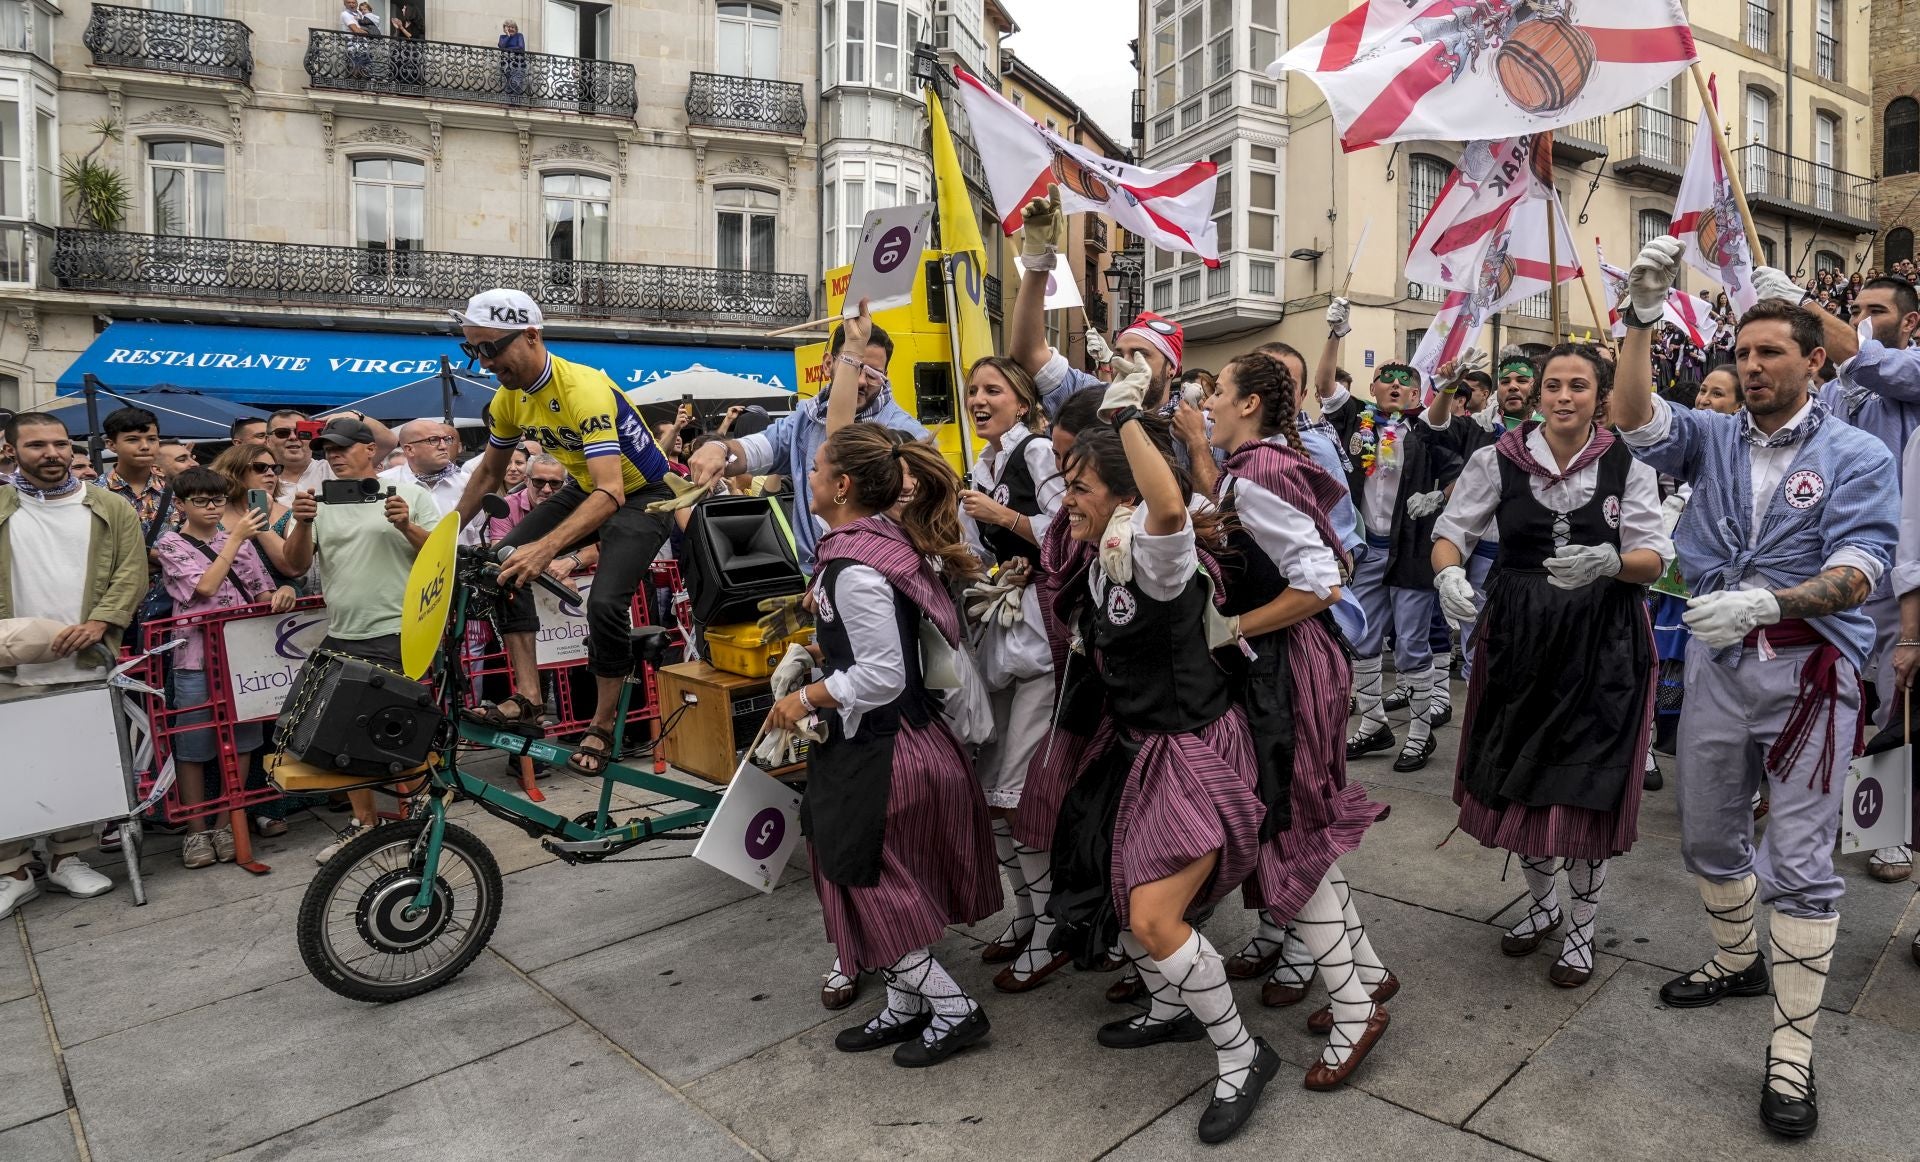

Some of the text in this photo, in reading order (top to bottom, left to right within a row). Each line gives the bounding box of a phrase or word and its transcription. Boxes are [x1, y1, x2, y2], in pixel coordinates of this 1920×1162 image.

[880, 236, 902, 265] 16
[490, 305, 529, 323] KAS
[104, 348, 311, 371] RESTAURANTE
[579, 414, 612, 434] KAS
[618, 414, 649, 453] KAS
[420, 568, 446, 612] KAS
[236, 665, 301, 694] kirol
[1858, 789, 1877, 816] 12
[756, 820, 775, 846] 5
